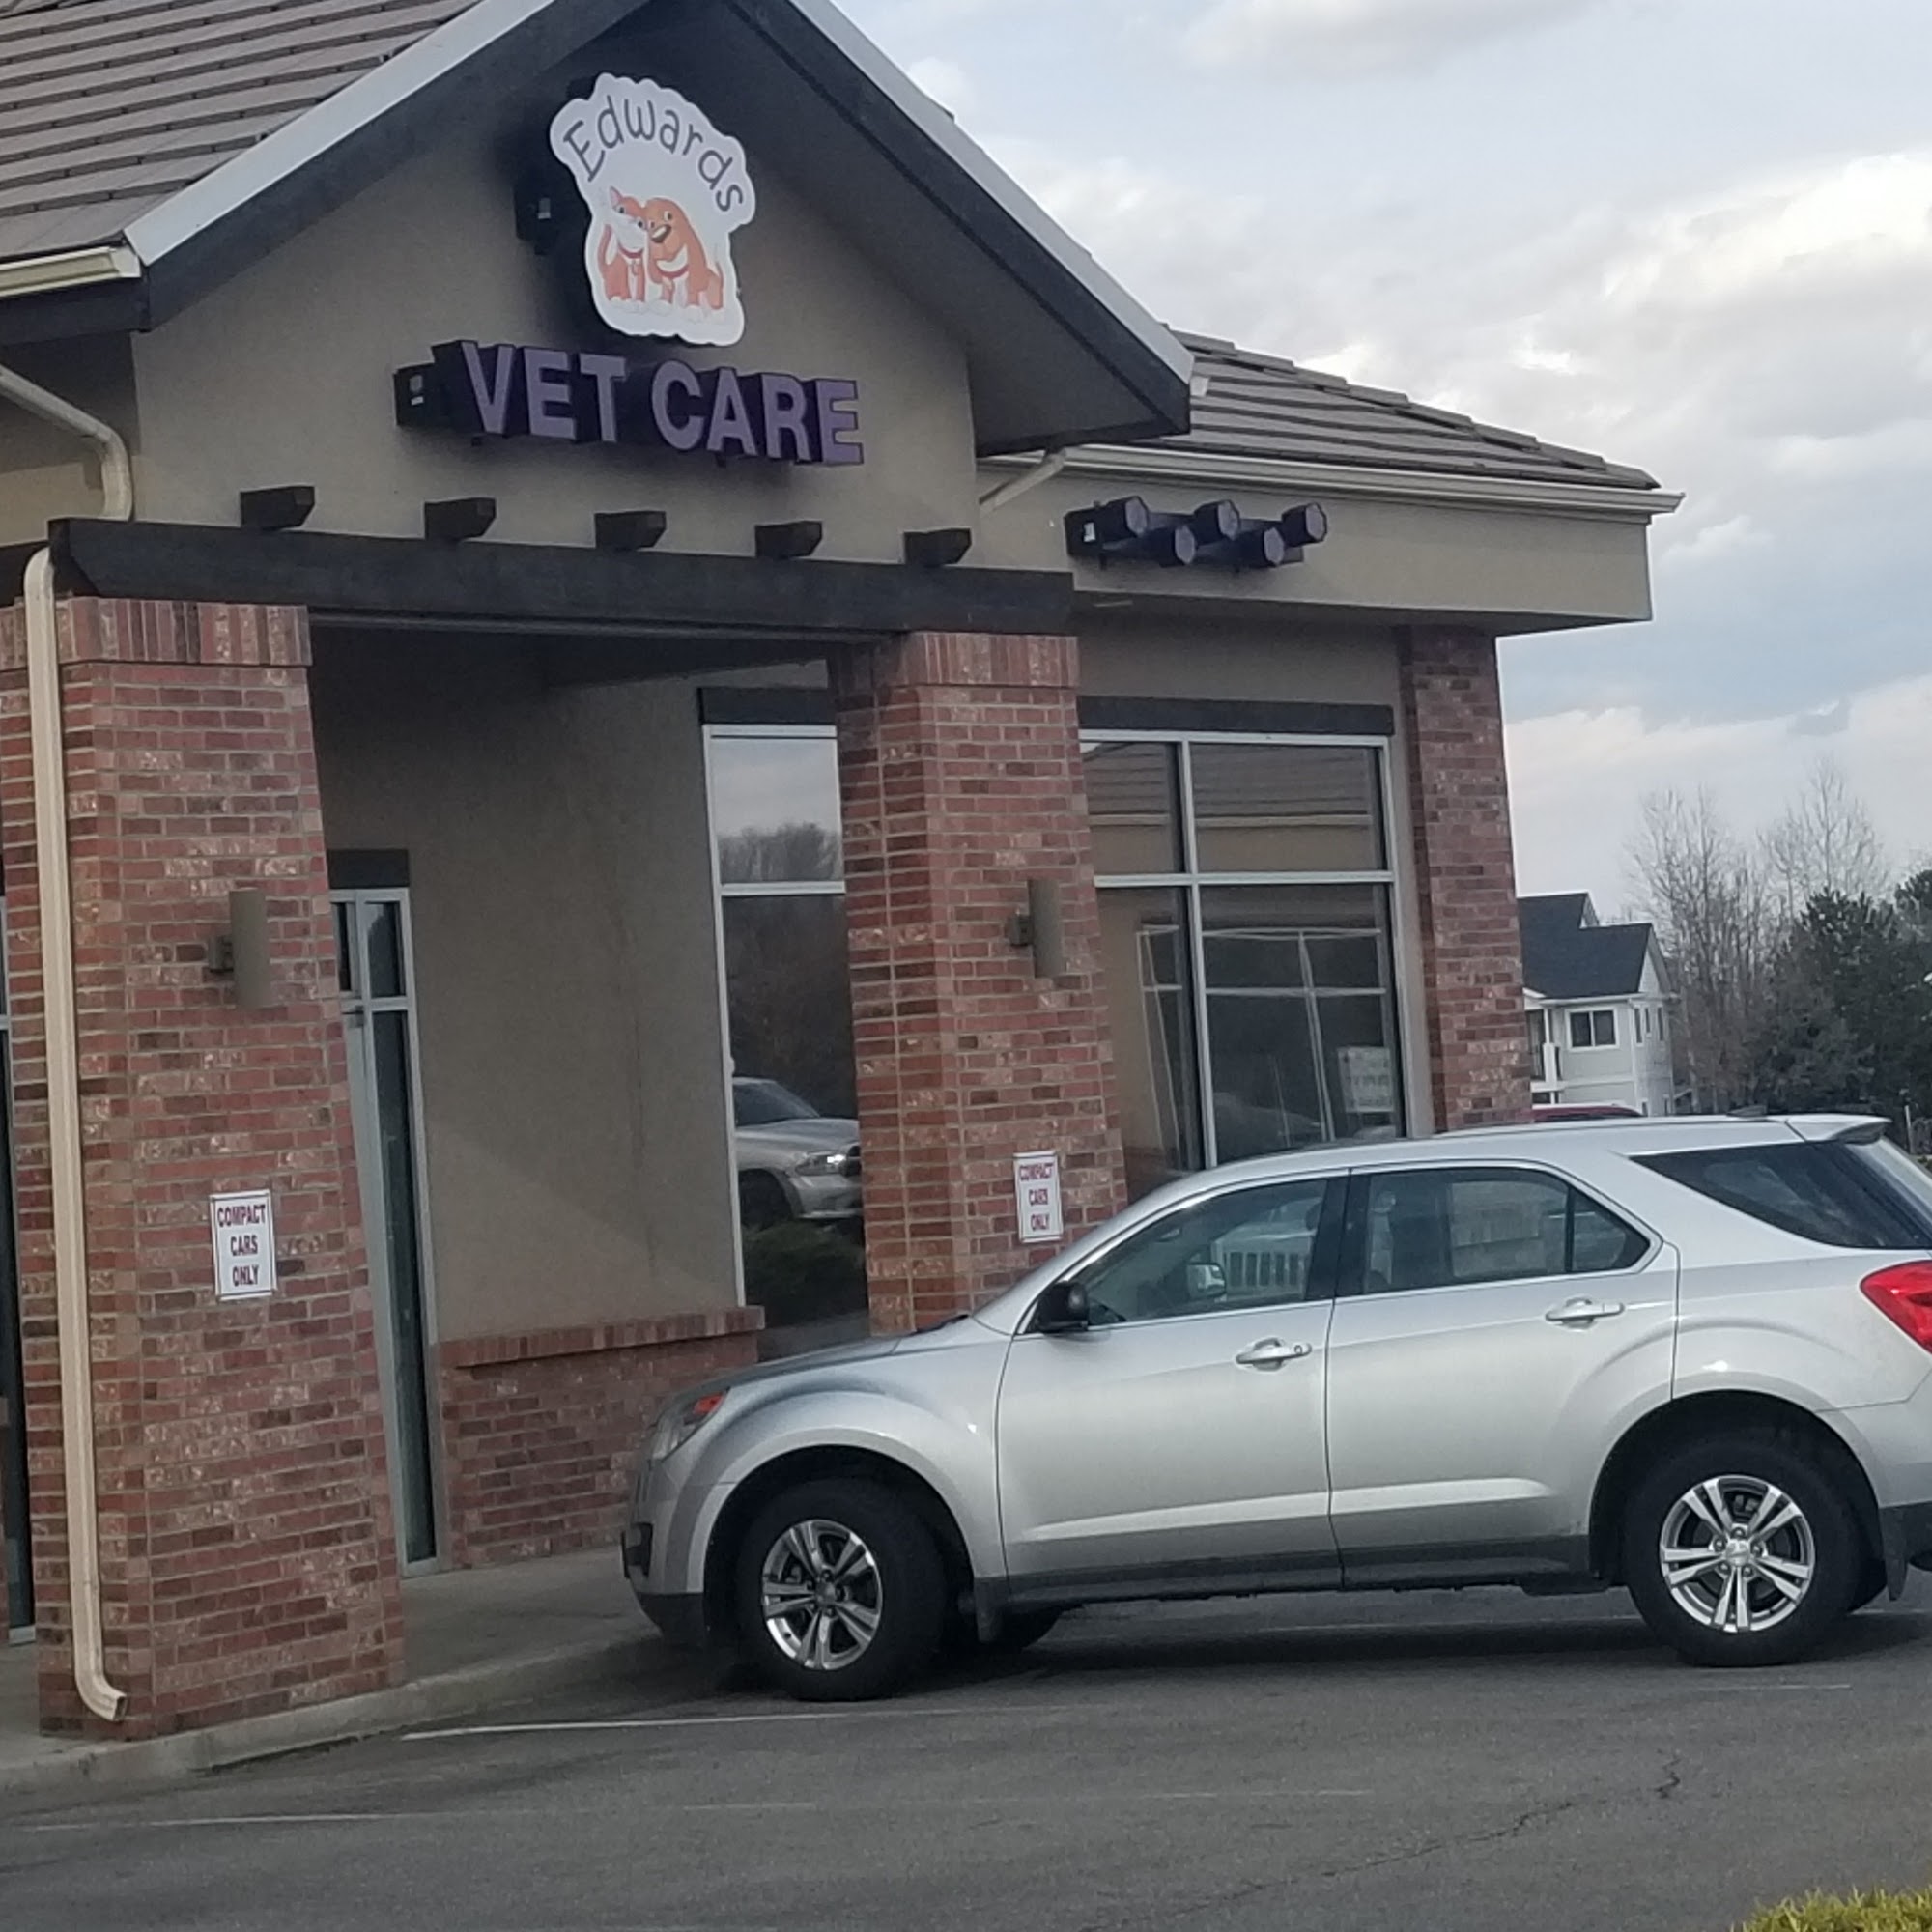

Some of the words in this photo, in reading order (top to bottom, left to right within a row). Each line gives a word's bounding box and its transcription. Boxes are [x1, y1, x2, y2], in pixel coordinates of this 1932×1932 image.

[562, 95, 744, 212] Edwards
[460, 340, 626, 443] VET
[651, 359, 865, 466] CARE
[216, 1204, 266, 1227] COMPACT
[230, 1235, 258, 1256] CARS
[232, 1264, 259, 1287] ONLY
